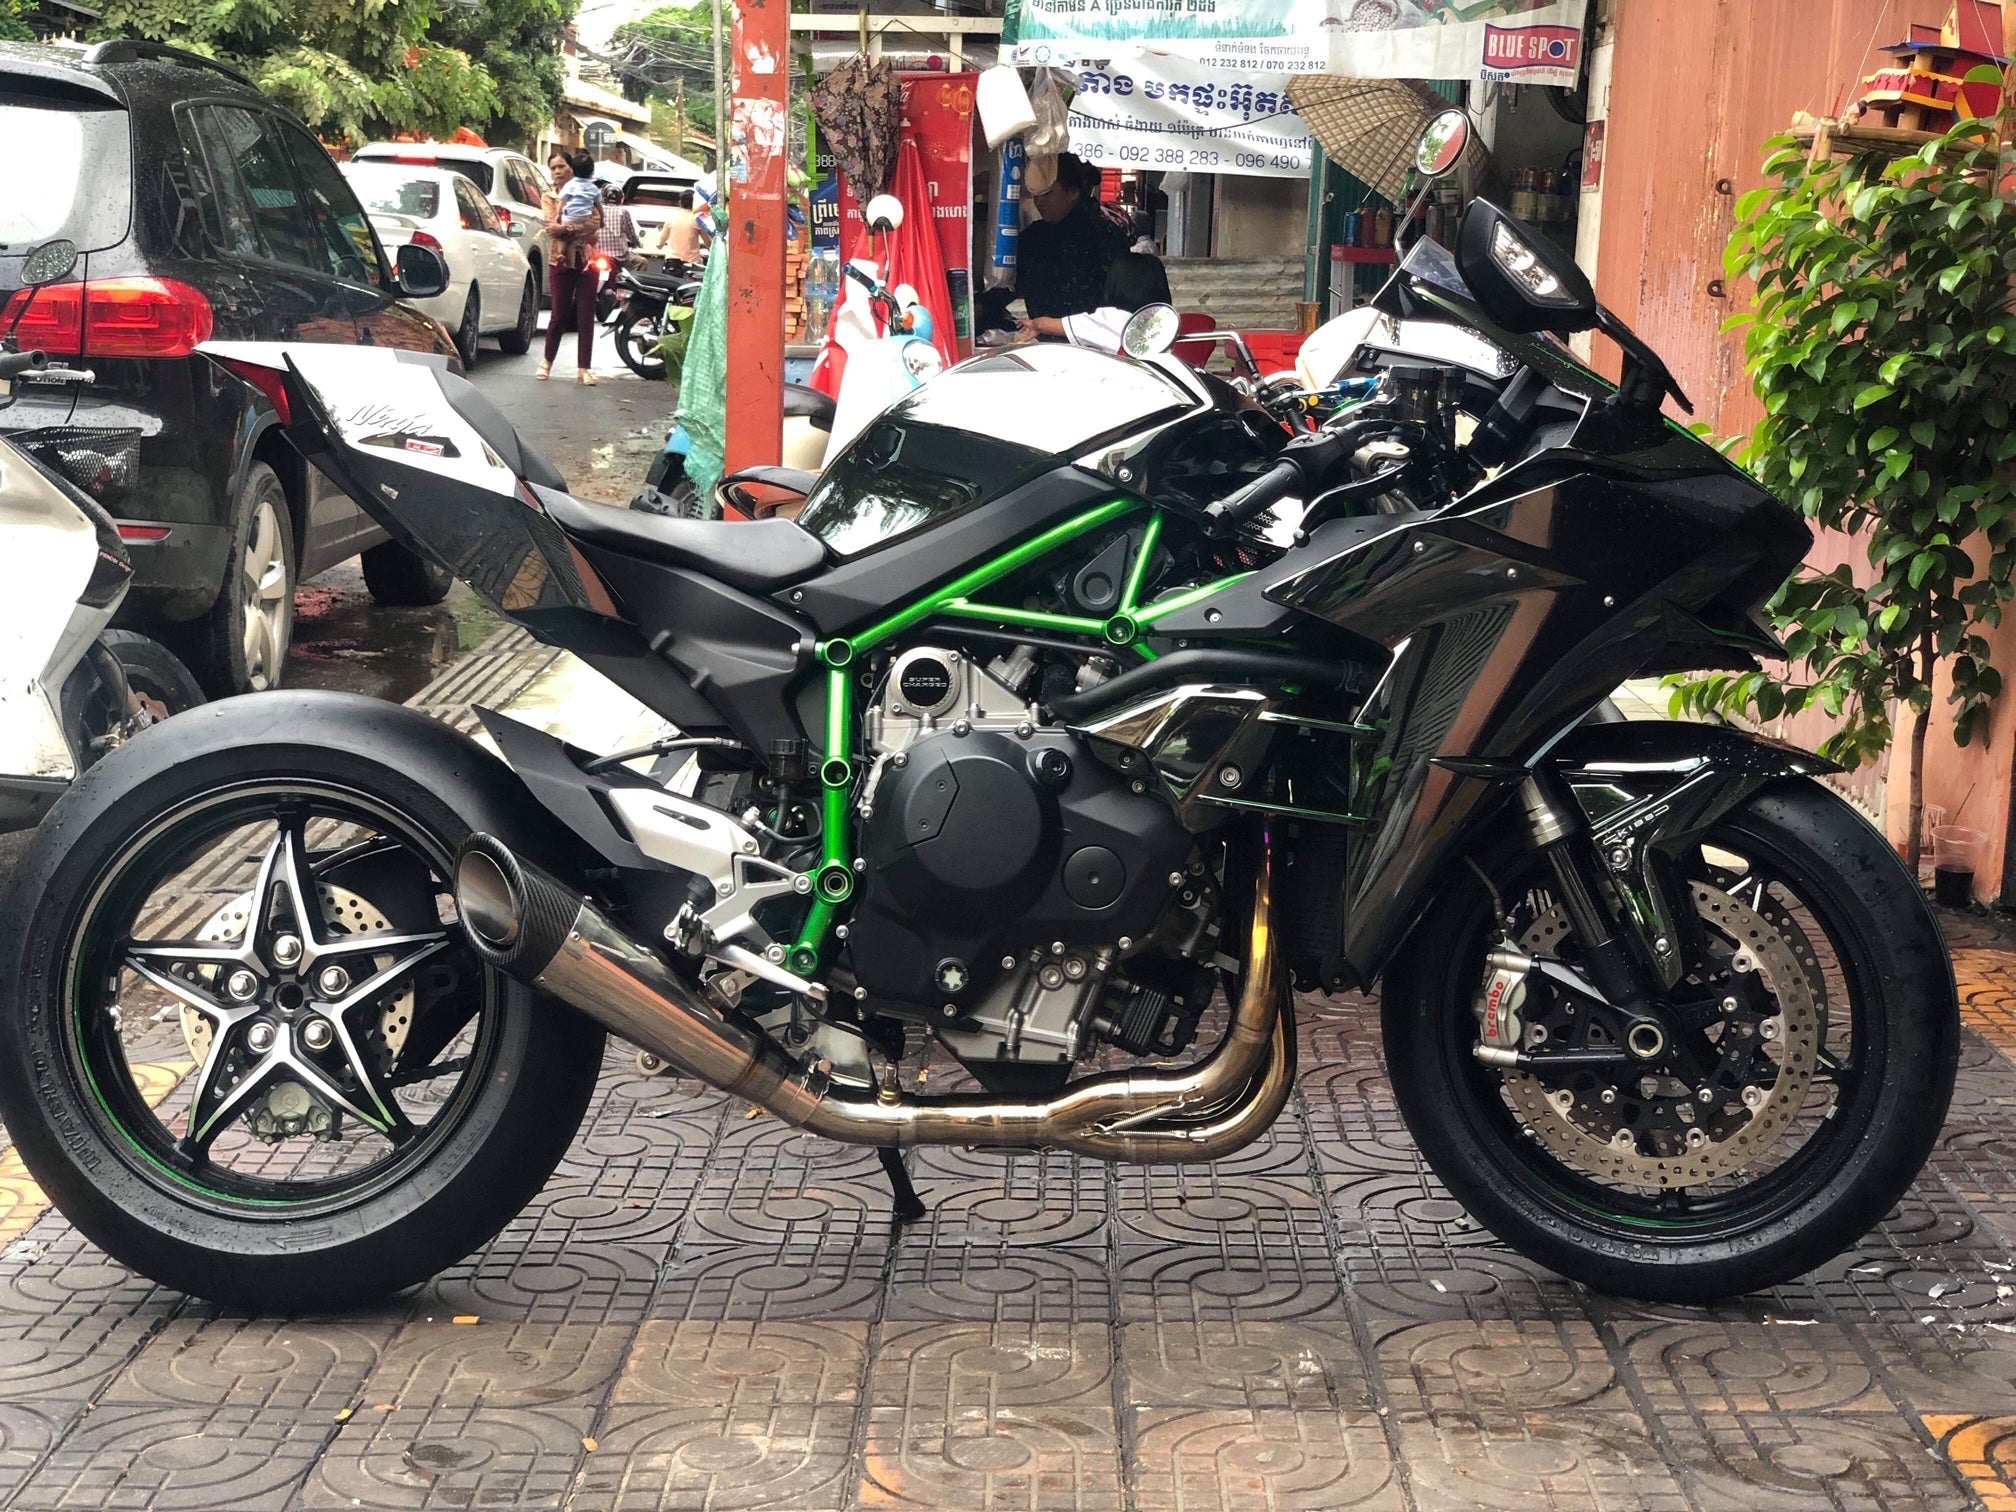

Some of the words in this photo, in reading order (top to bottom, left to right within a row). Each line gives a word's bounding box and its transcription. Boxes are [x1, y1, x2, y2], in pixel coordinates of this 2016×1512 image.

[1090, 0, 1101, 11] A
[1488, 34, 1524, 58] BLUE
[1528, 36, 1575, 60] SPOT
[1199, 57, 1217, 67] 012
[1220, 58, 1237, 68] 232
[1240, 59, 1258, 69] 812
[1266, 60, 1284, 70] 070
[1287, 61, 1305, 70] 232
[1308, 61, 1326, 70] 812
[1075, 142, 1104, 159] 386
[1119, 145, 1149, 162] 092
[1155, 148, 1184, 164] 388
[1189, 151, 1218, 166] 283
[1235, 153, 1265, 168] 096
[1270, 155, 1300, 170] 490
[345, 404, 433, 436] Ninja
[1485, 981, 1504, 1038] brembo
